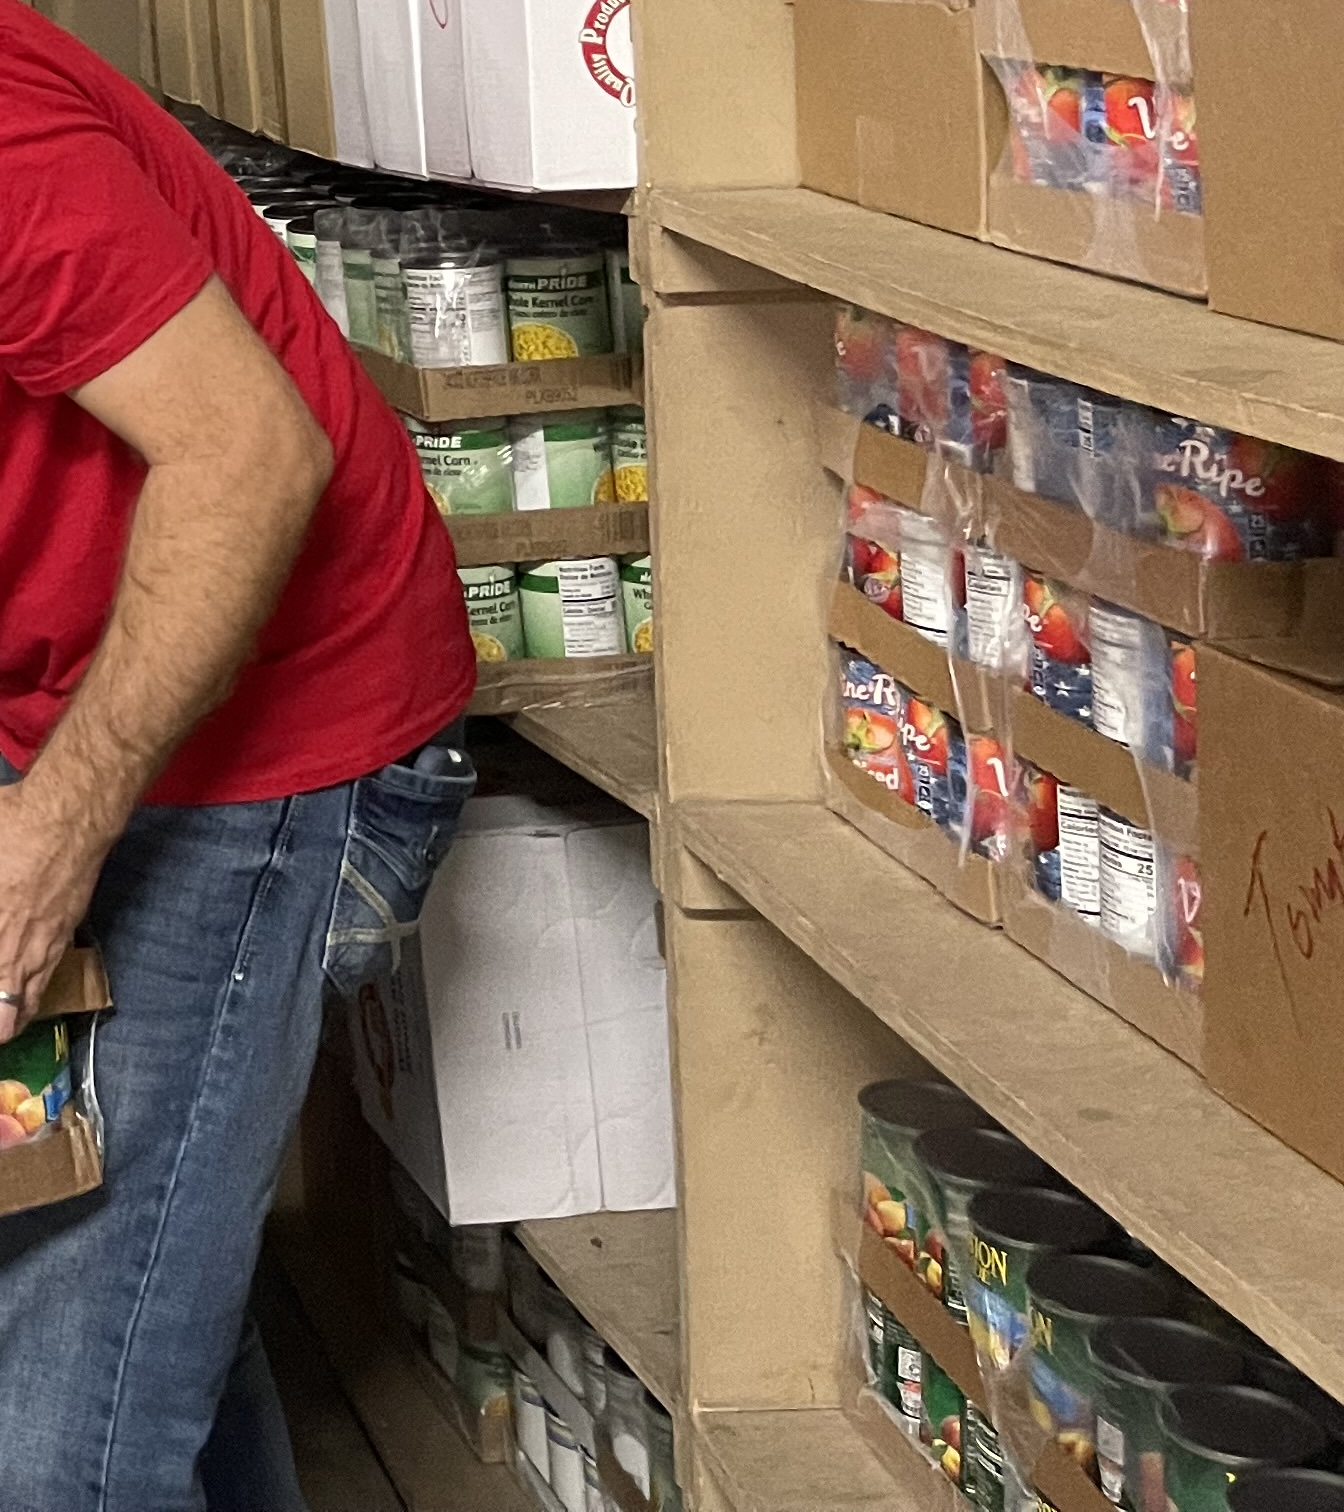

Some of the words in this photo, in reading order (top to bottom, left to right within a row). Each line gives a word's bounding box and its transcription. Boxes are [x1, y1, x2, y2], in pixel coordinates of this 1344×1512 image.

[537, 274, 588, 290] PRIDE
[531, 294, 571, 309] Kernel
[571, 294, 595, 307] Corn
[415, 435, 463, 450] PRIDE
[443, 455, 471, 467] Corn
[1178, 437, 1267, 499] Ripe
[467, 579, 512, 599] PRIDE
[1137, 862, 1155, 876] 25
